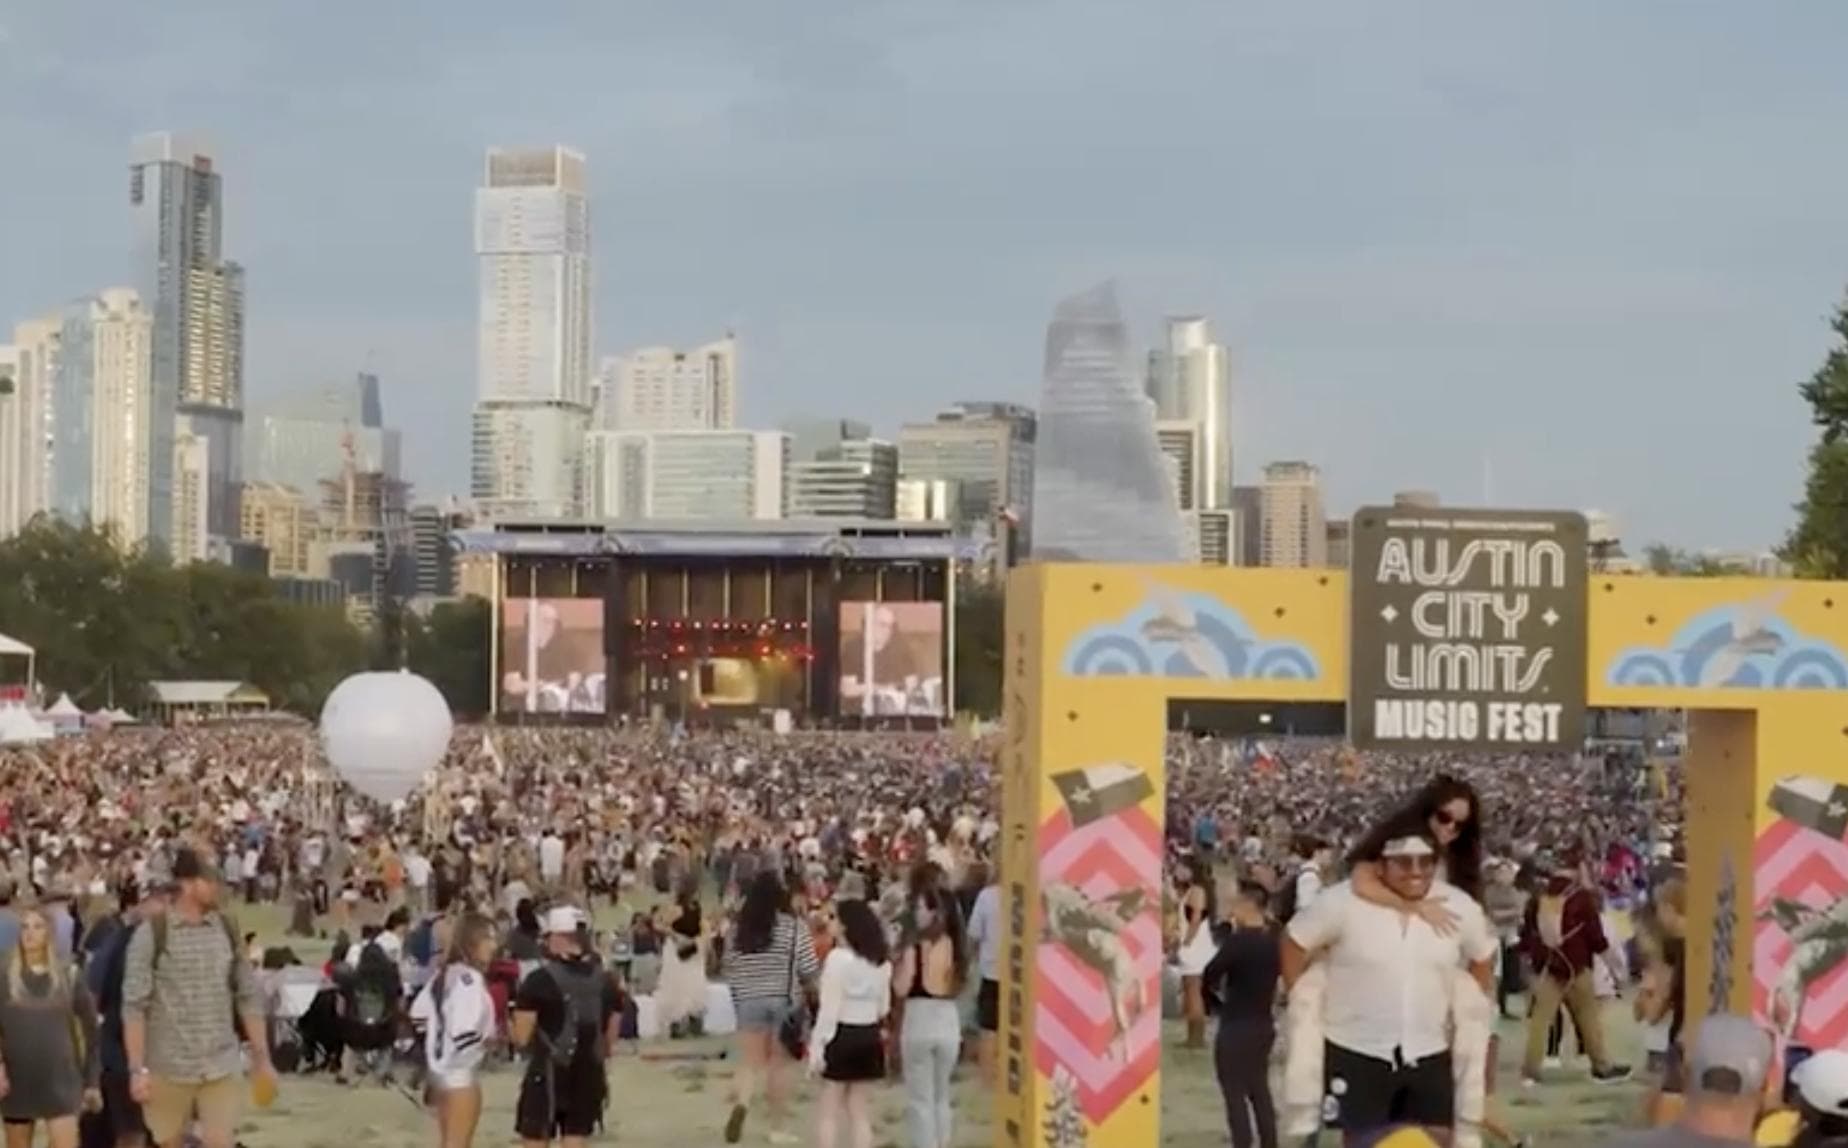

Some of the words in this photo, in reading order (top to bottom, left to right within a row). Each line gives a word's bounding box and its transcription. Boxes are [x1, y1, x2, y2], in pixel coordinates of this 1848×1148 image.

[1376, 537, 1566, 588] AUSTIN
[1411, 590, 1530, 639] CITY
[1385, 643, 1553, 693] LIMITS
[1374, 698, 1479, 740] MUSIC
[1487, 701, 1563, 742] FEST
